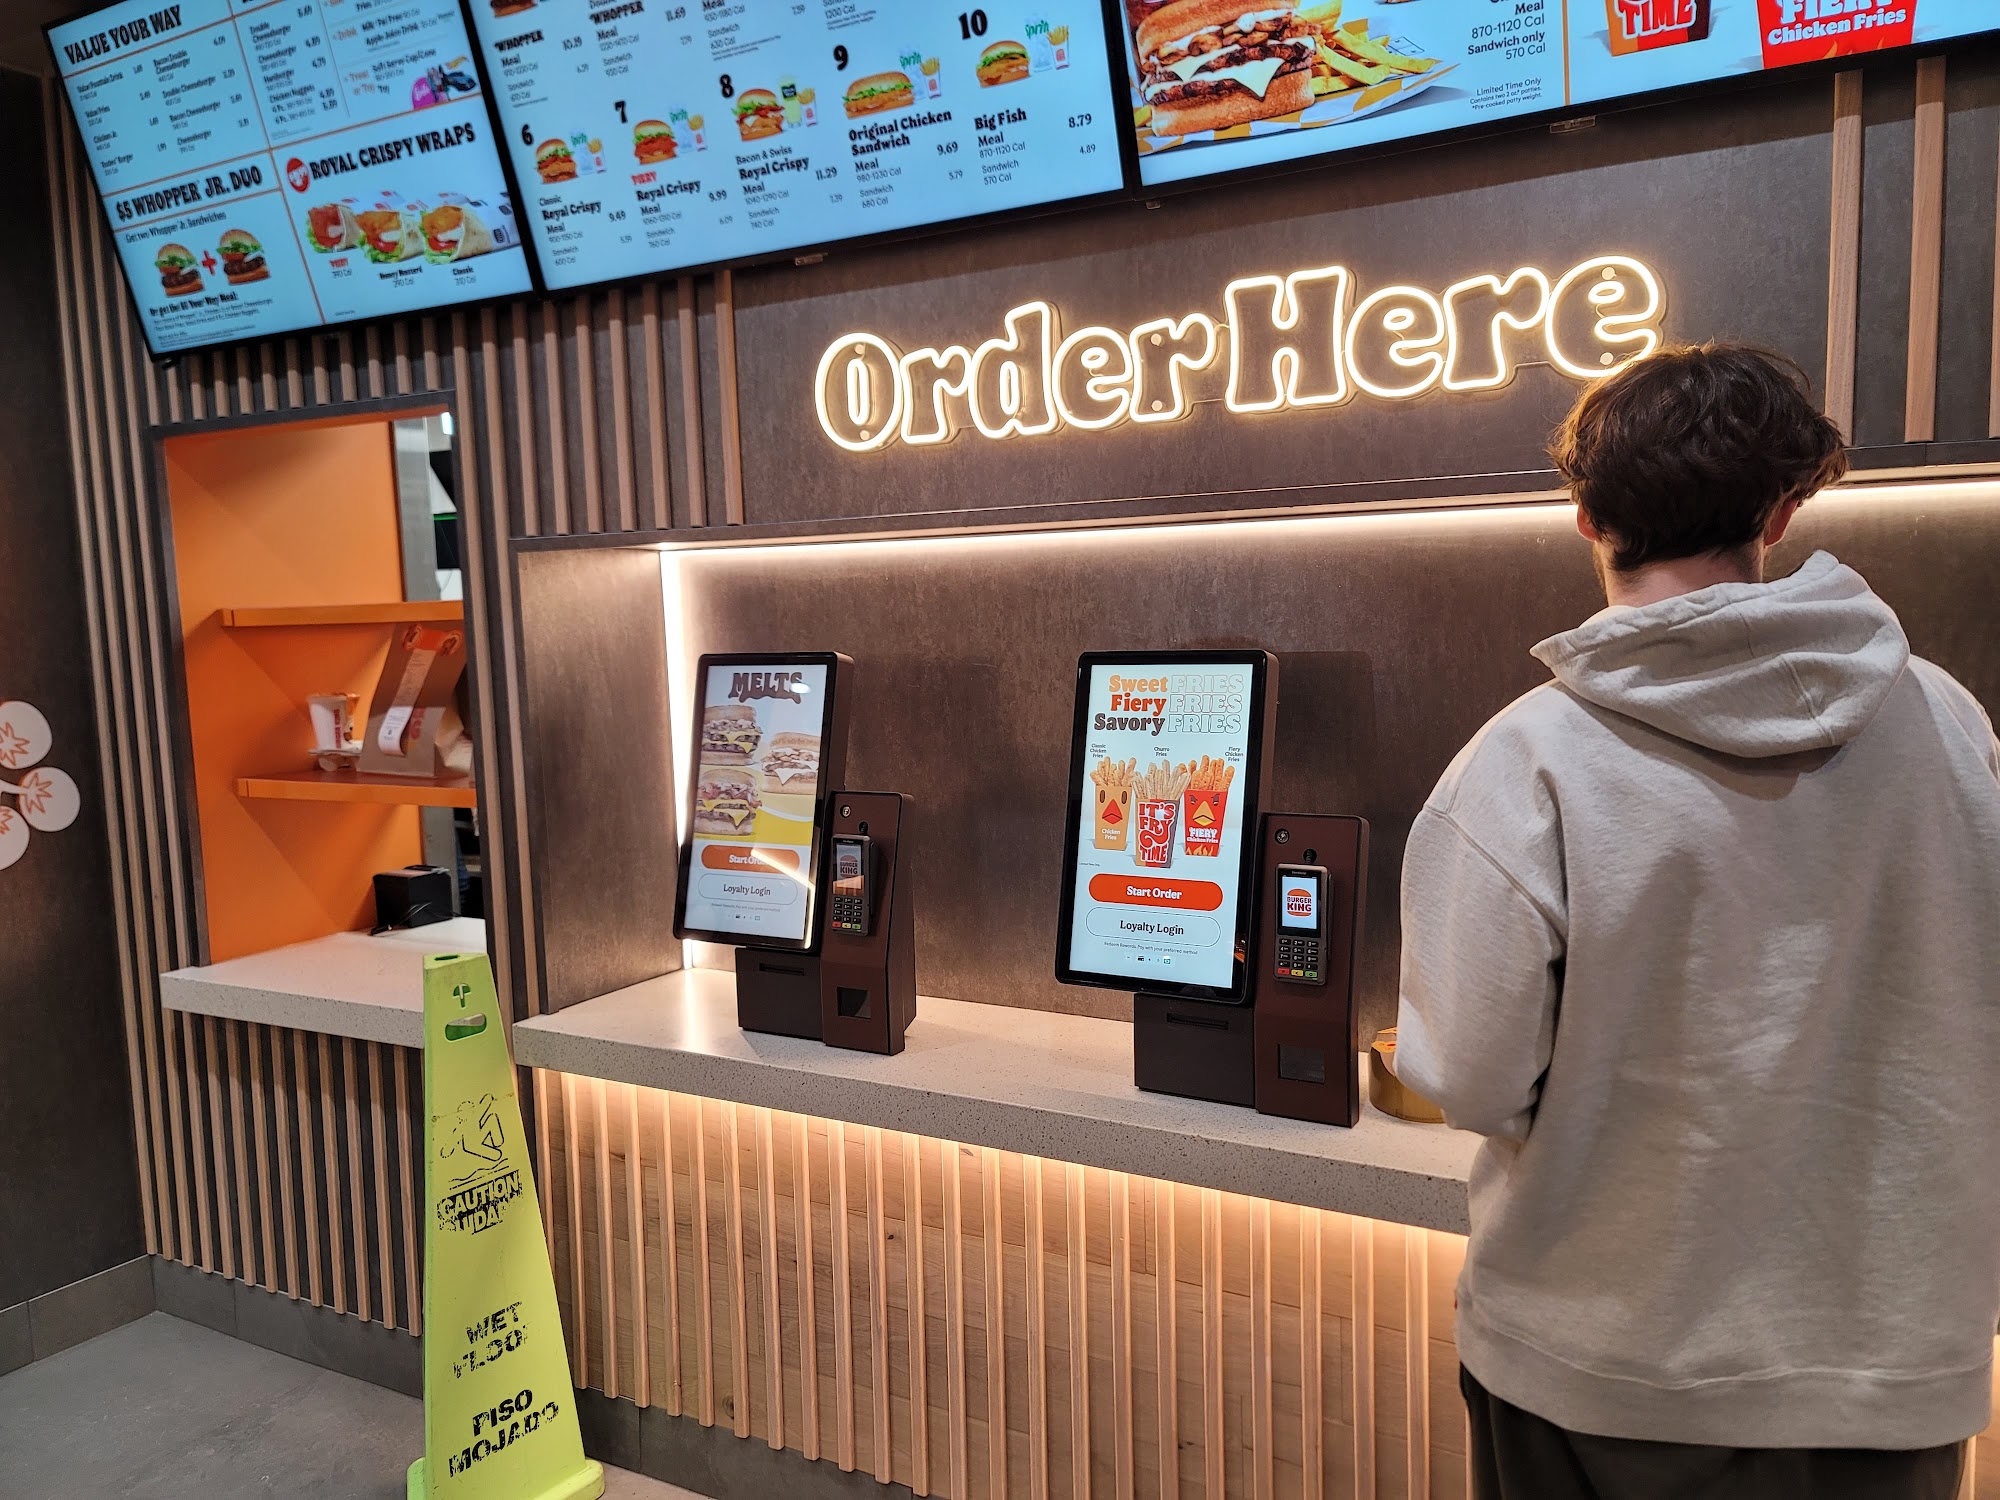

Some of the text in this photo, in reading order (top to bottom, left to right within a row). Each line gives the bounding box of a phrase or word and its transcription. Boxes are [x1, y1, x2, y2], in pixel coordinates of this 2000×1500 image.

[589, 1, 645, 25] WHOPPER
[841, 4, 856, 16] Cal
[1514, 0, 1545, 16] Meal
[958, 9, 987, 40] 10
[1471, 13, 1546, 40] 870-1120 Cal
[1615, 0, 1696, 38] TIME
[1767, 8, 1907, 46] Chicken Fries
[64, 5, 183, 65] VALUE YOUR WAY
[596, 25, 619, 41] Meal
[708, 23, 740, 38] Sandwich
[494, 30, 545, 53] WHOPPER
[1467, 30, 1546, 56] Sandwich only
[602, 52, 633, 67] Sandwich
[833, 44, 849, 71] 9
[1505, 43, 1546, 60] 570 Cal
[501, 54, 522, 68] Meal
[718, 73, 735, 99] 8
[1476, 77, 1542, 96] Limited Time Only
[1470, 94, 1495, 105] Contains
[1495, 92, 1506, 100] two
[1506, 97, 1521, 107] patty
[614, 101, 628, 124] 7
[974, 107, 1028, 134] Big Fish
[849, 108, 953, 142] Original Chicken
[1067, 113, 1093, 129] 8.79
[521, 124, 534, 146] 6
[977, 132, 1005, 148] Meal
[309, 153, 358, 180] ROYAL
[358, 138, 415, 168] CRISPY
[415, 122, 476, 153] WRAPS
[851, 134, 912, 158] Sandwich
[936, 141, 960, 157] 9.69
[979, 141, 1027, 160] 870-1120 Cal
[1079, 143, 1097, 156] 4.89
[735, 145, 794, 166] Bacon & Swiss
[738, 157, 811, 182] Royal Crispy
[855, 158, 880, 173] Meal
[889, 167, 902, 178] Cal
[981, 159, 1020, 175] Sandwich
[630, 171, 657, 186] FIERY
[815, 166, 839, 182] 11.29
[983, 172, 1013, 187] 570 Cal
[116, 201, 134, 222] $5
[133, 182, 201, 217] WHOPPER
[205, 176, 230, 198] JR.
[229, 165, 263, 191] DUO
[636, 180, 702, 204] Royal Crispy
[708, 190, 728, 204] 9.99
[743, 182, 766, 196] Meal
[859, 184, 895, 199] Sandwich
[539, 195, 562, 208] Classic
[876, 196, 889, 206] Cal
[542, 200, 602, 222] Royal Crispy
[608, 210, 627, 223] 9.49
[640, 204, 661, 217] Meal
[748, 207, 780, 220] Sandwich
[188, 211, 227, 229] Sandwiches
[546, 222, 566, 236] Meal
[646, 227, 676, 240] Sandwich
[552, 245, 580, 258] Sandwich
[452, 265, 475, 277] Classic
[815, 255, 1664, 453] Order Here
[728, 672, 804, 704] MELTS
[1108, 674, 1245, 693] Sweet FRIES
[1110, 692, 1243, 717] Fiery FRIES
[1093, 712, 1242, 737] Savory FRIES
[1138, 803, 1175, 818] IT'S
[1101, 828, 1120, 836] Chicken
[1188, 826, 1218, 839] FIERY
[729, 854, 749, 866] Start
[1139, 845, 1168, 862] TIME
[840, 866, 859, 875] KING
[723, 883, 771, 898] Loyalty Login
[1126, 885, 1183, 900] Start Order
[1287, 896, 1312, 904] BURGER
[1287, 903, 1312, 913] KING
[1119, 920, 1184, 937] Loyalty Login
[437, 1170, 521, 1222] CAUTION
[466, 1301, 522, 1345] WET
[472, 1389, 534, 1436] PISO
[448, 1402, 560, 1478] MOJADO
